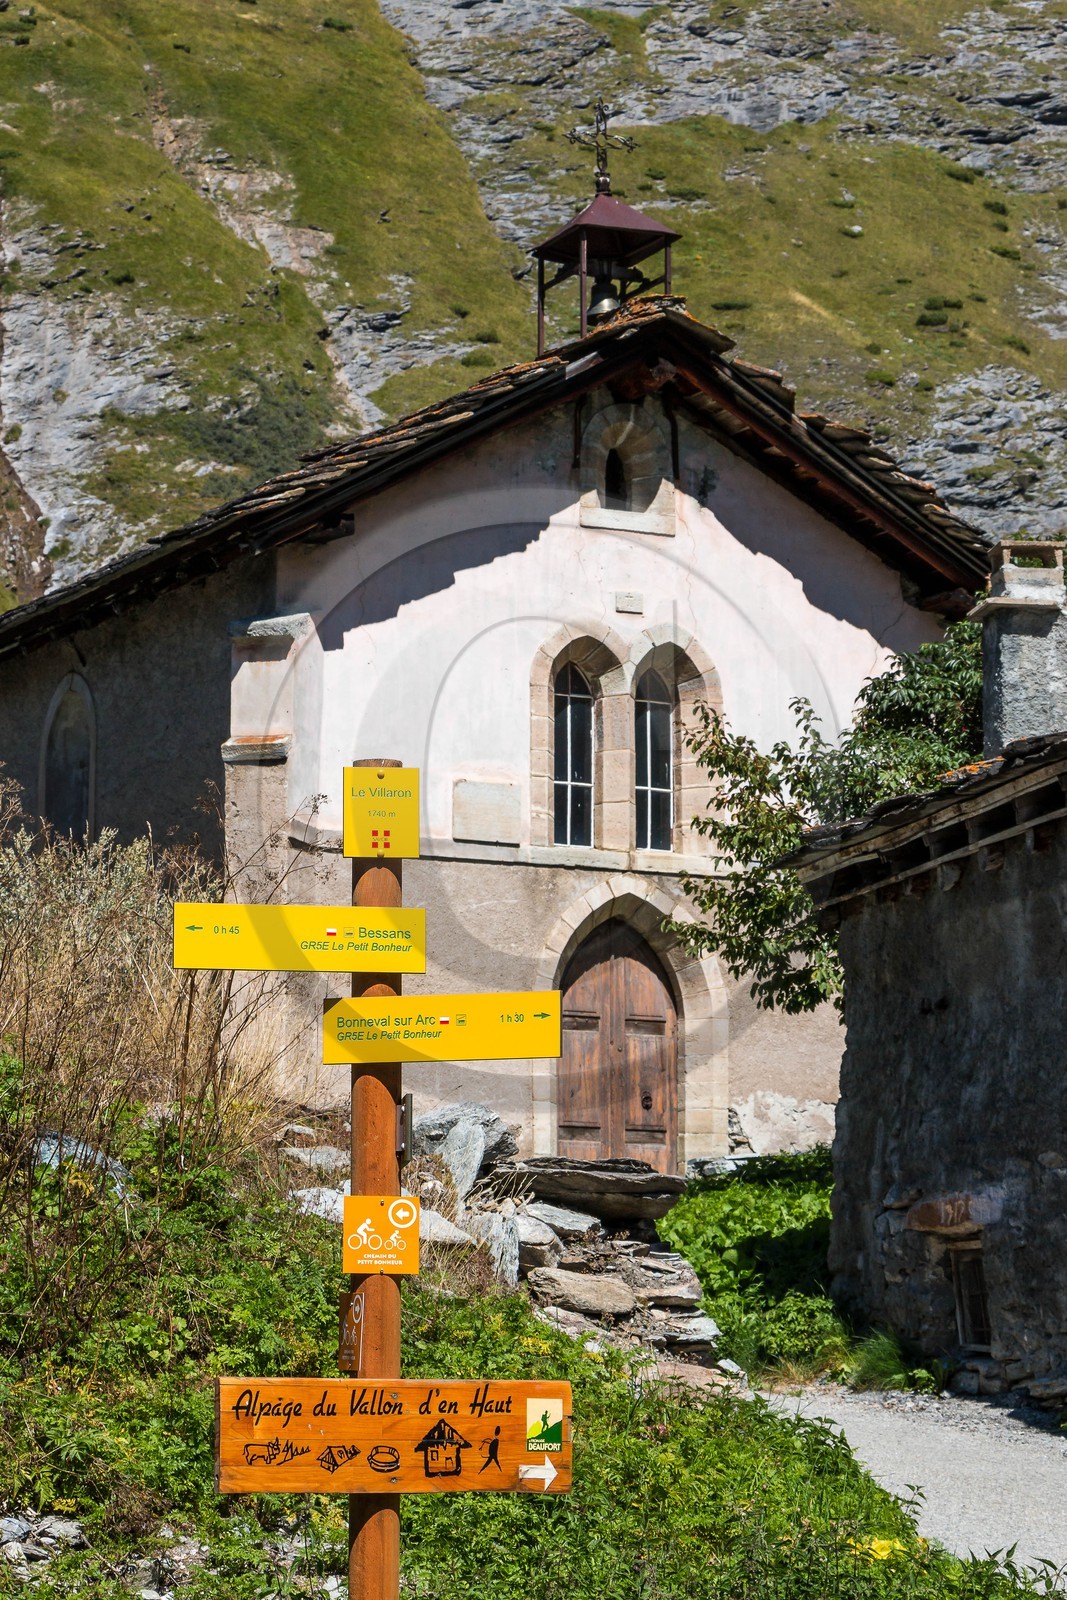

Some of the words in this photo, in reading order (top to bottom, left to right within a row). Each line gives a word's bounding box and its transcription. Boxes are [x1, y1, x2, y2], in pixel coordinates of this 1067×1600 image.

[351, 786, 366, 798] Le
[368, 786, 412, 798] Villaron
[368, 810, 387, 818] 1740
[213, 925, 220, 934] 0
[221, 925, 227, 934] h
[228, 925, 240, 935] 45
[358, 927, 412, 940] Bessans
[300, 941, 330, 951] GR5E
[331, 941, 344, 951] Le
[346, 941, 369, 952] Petit
[371, 942, 413, 952] Bonheur
[336, 1015, 391, 1029] Bonneval
[394, 1017, 413, 1027] sur
[415, 1014, 437, 1026] Arc
[507, 1014, 513, 1023] h
[514, 1013, 526, 1023] 30
[336, 1031, 365, 1042] GR5E
[366, 1030, 379, 1041] Le
[380, 1030, 402, 1040] Petit
[403, 1029, 443, 1040] Bonheur
[312, 1390, 337, 1417] du
[349, 1388, 403, 1417] Vallon
[418, 1387, 459, 1416] d'en
[468, 1383, 513, 1418] Haut
